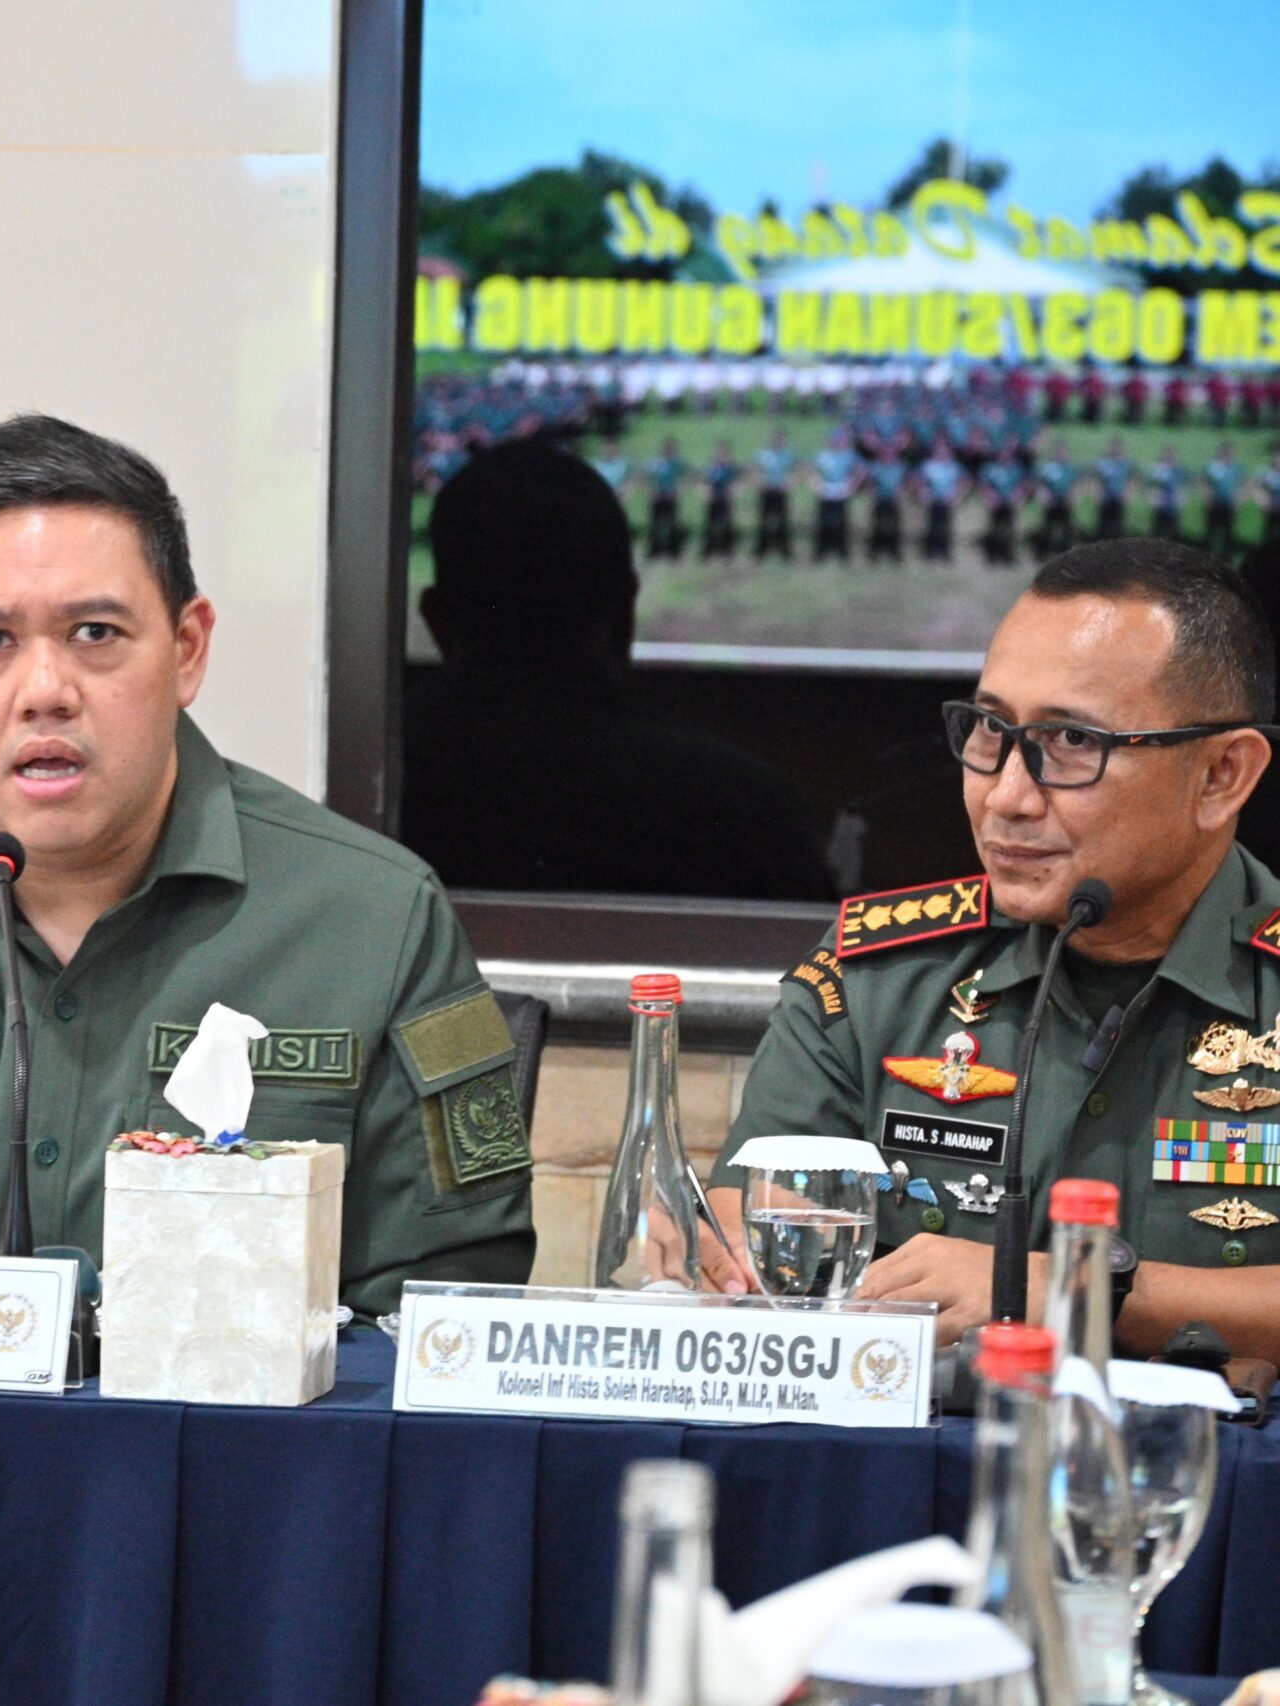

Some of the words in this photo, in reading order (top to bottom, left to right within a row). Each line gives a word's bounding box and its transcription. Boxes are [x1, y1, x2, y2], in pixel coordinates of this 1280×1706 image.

[842, 902, 864, 947] TNI
[158, 1029, 318, 1071] KISI
[894, 1124, 928, 1143] HISTA.
[486, 1319, 661, 1372] DANREM
[675, 1327, 842, 1381] 063/SGJ
[498, 1370, 544, 1395] Kolonel
[547, 1372, 564, 1398] Inf
[568, 1374, 600, 1400] Hista
[603, 1375, 637, 1401] Soleh
[641, 1378, 696, 1411] Harahap,
